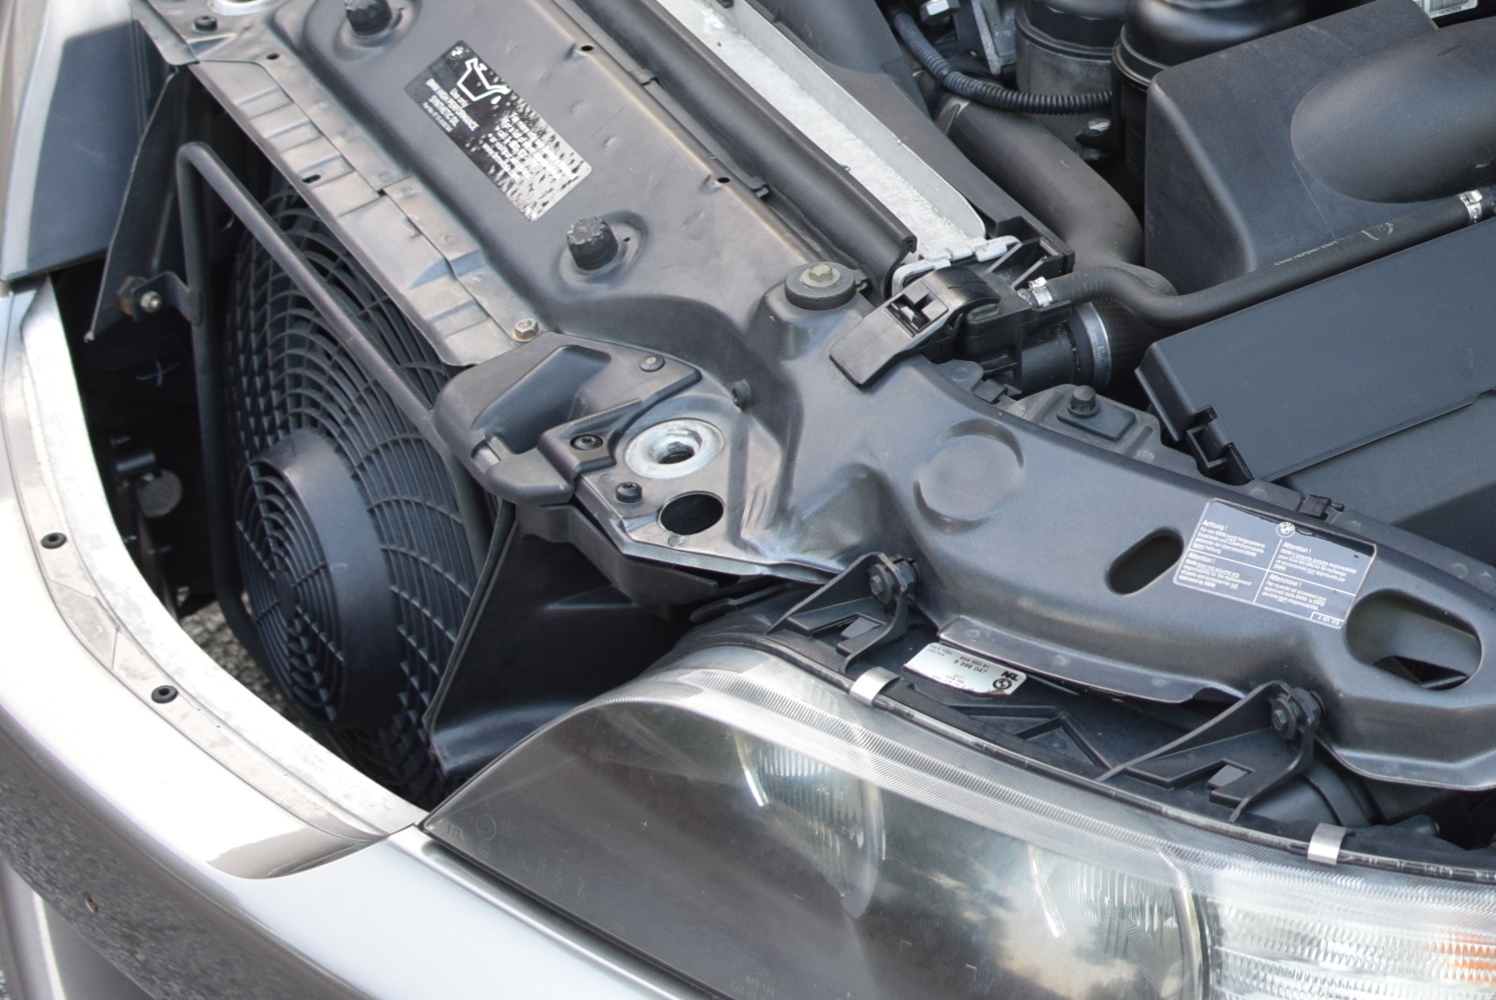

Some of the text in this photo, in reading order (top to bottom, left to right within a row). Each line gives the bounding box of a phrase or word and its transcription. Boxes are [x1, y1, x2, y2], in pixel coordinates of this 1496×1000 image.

[444, 97, 479, 132] PERFORMANCE
[1201, 518, 1225, 531] Achtung
[1282, 541, 1308, 553] Attention
[1187, 551, 1212, 563] Attention
[1268, 573, 1299, 587] Attenzione
